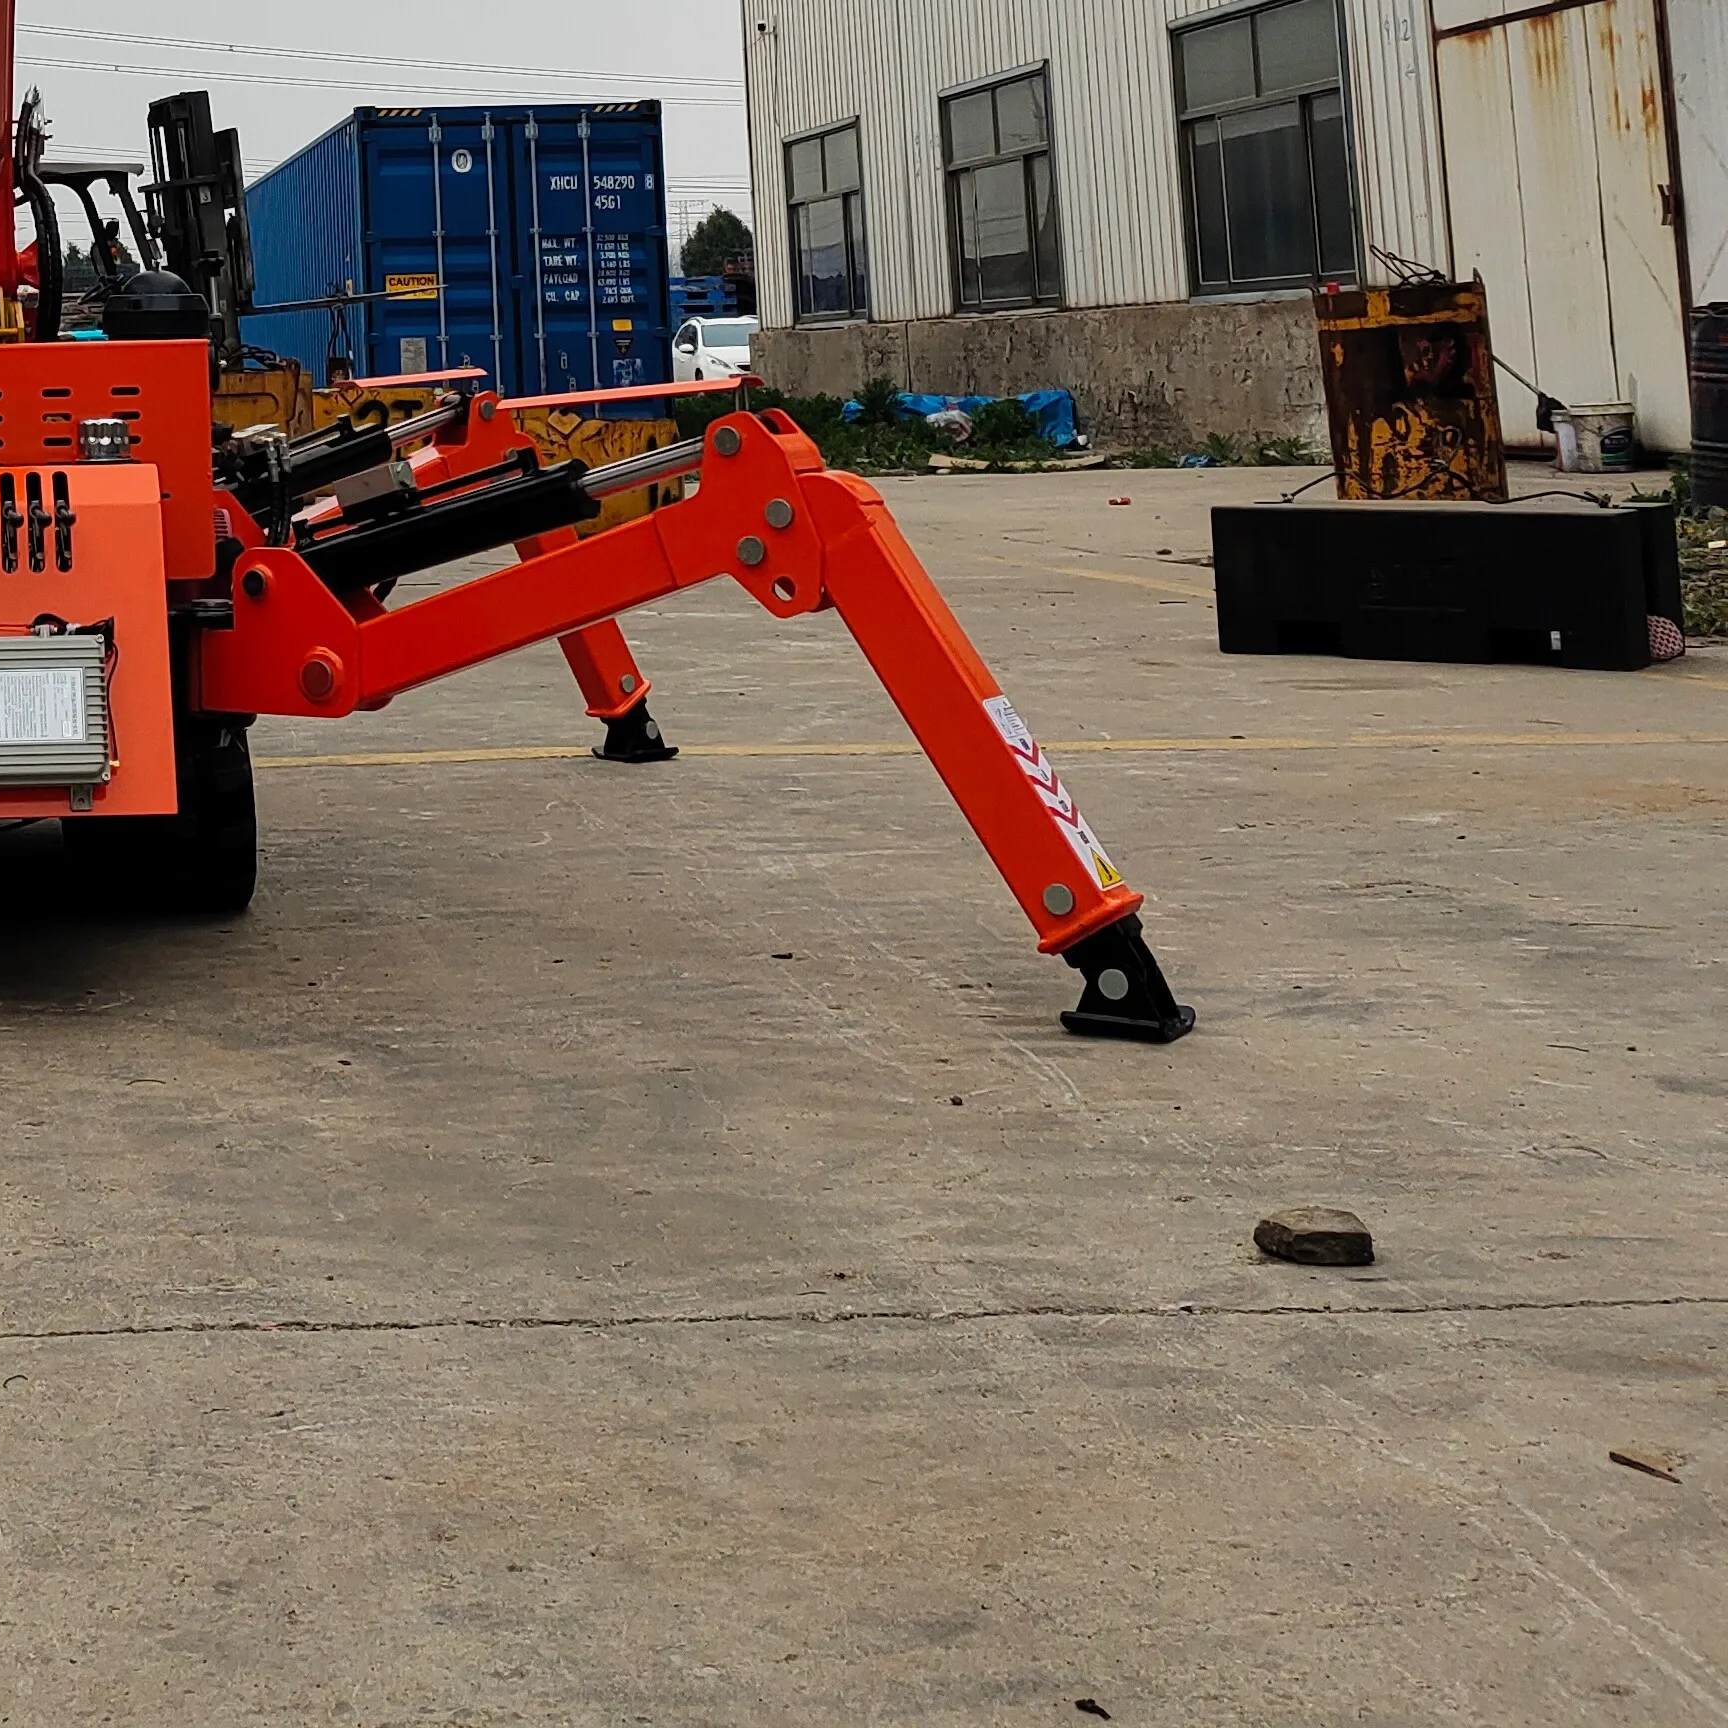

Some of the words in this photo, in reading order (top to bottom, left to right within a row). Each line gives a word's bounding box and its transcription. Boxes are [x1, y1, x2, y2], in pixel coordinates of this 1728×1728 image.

[593, 175, 635, 190] 548290
[594, 195, 621, 209] 45G1
[389, 277, 434, 286] CAUTION
